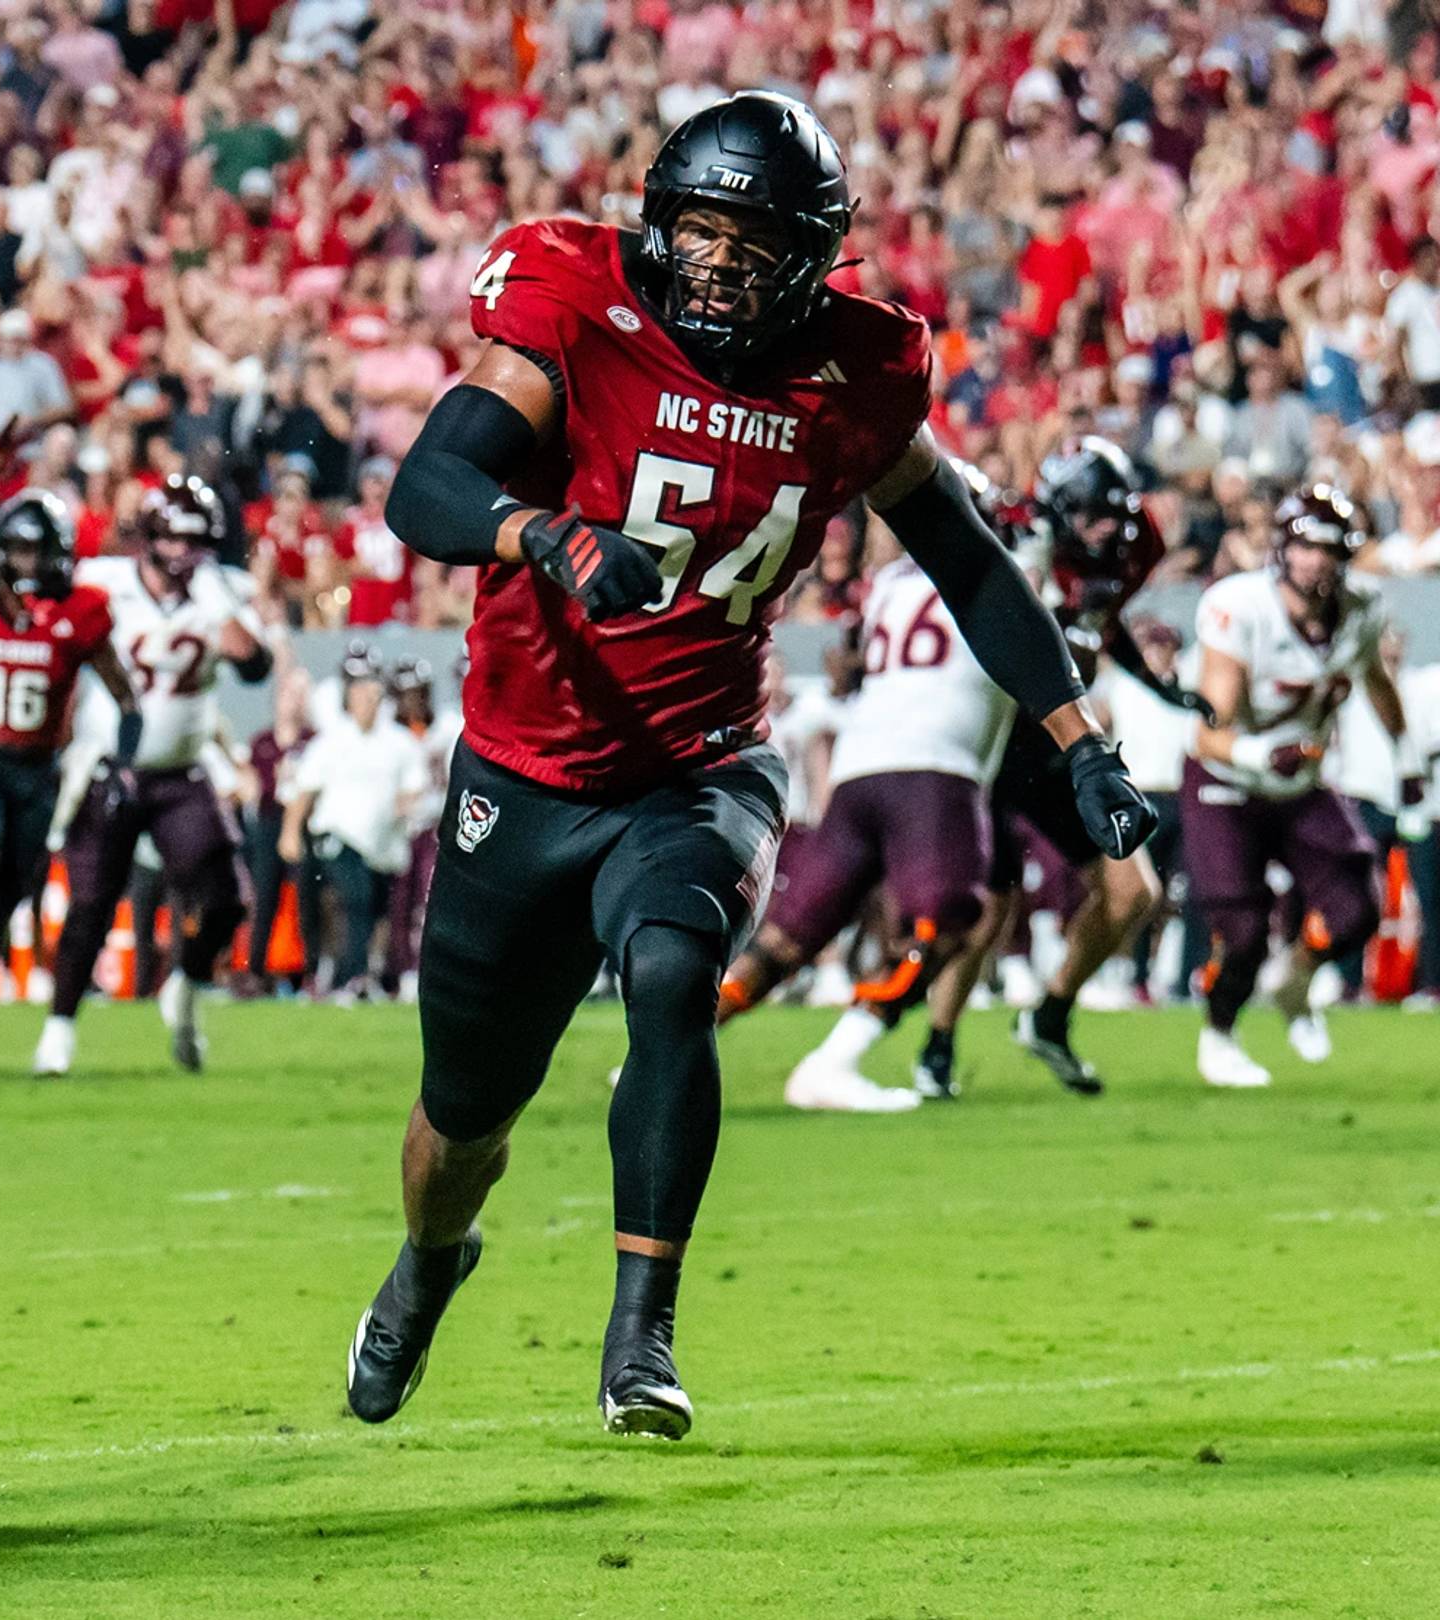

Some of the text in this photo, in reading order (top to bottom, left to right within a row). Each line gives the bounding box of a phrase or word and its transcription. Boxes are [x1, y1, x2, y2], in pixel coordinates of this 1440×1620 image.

[615, 311, 636, 328] ACC
[656, 391, 799, 453] NC STATE
[621, 451, 807, 626] 54
